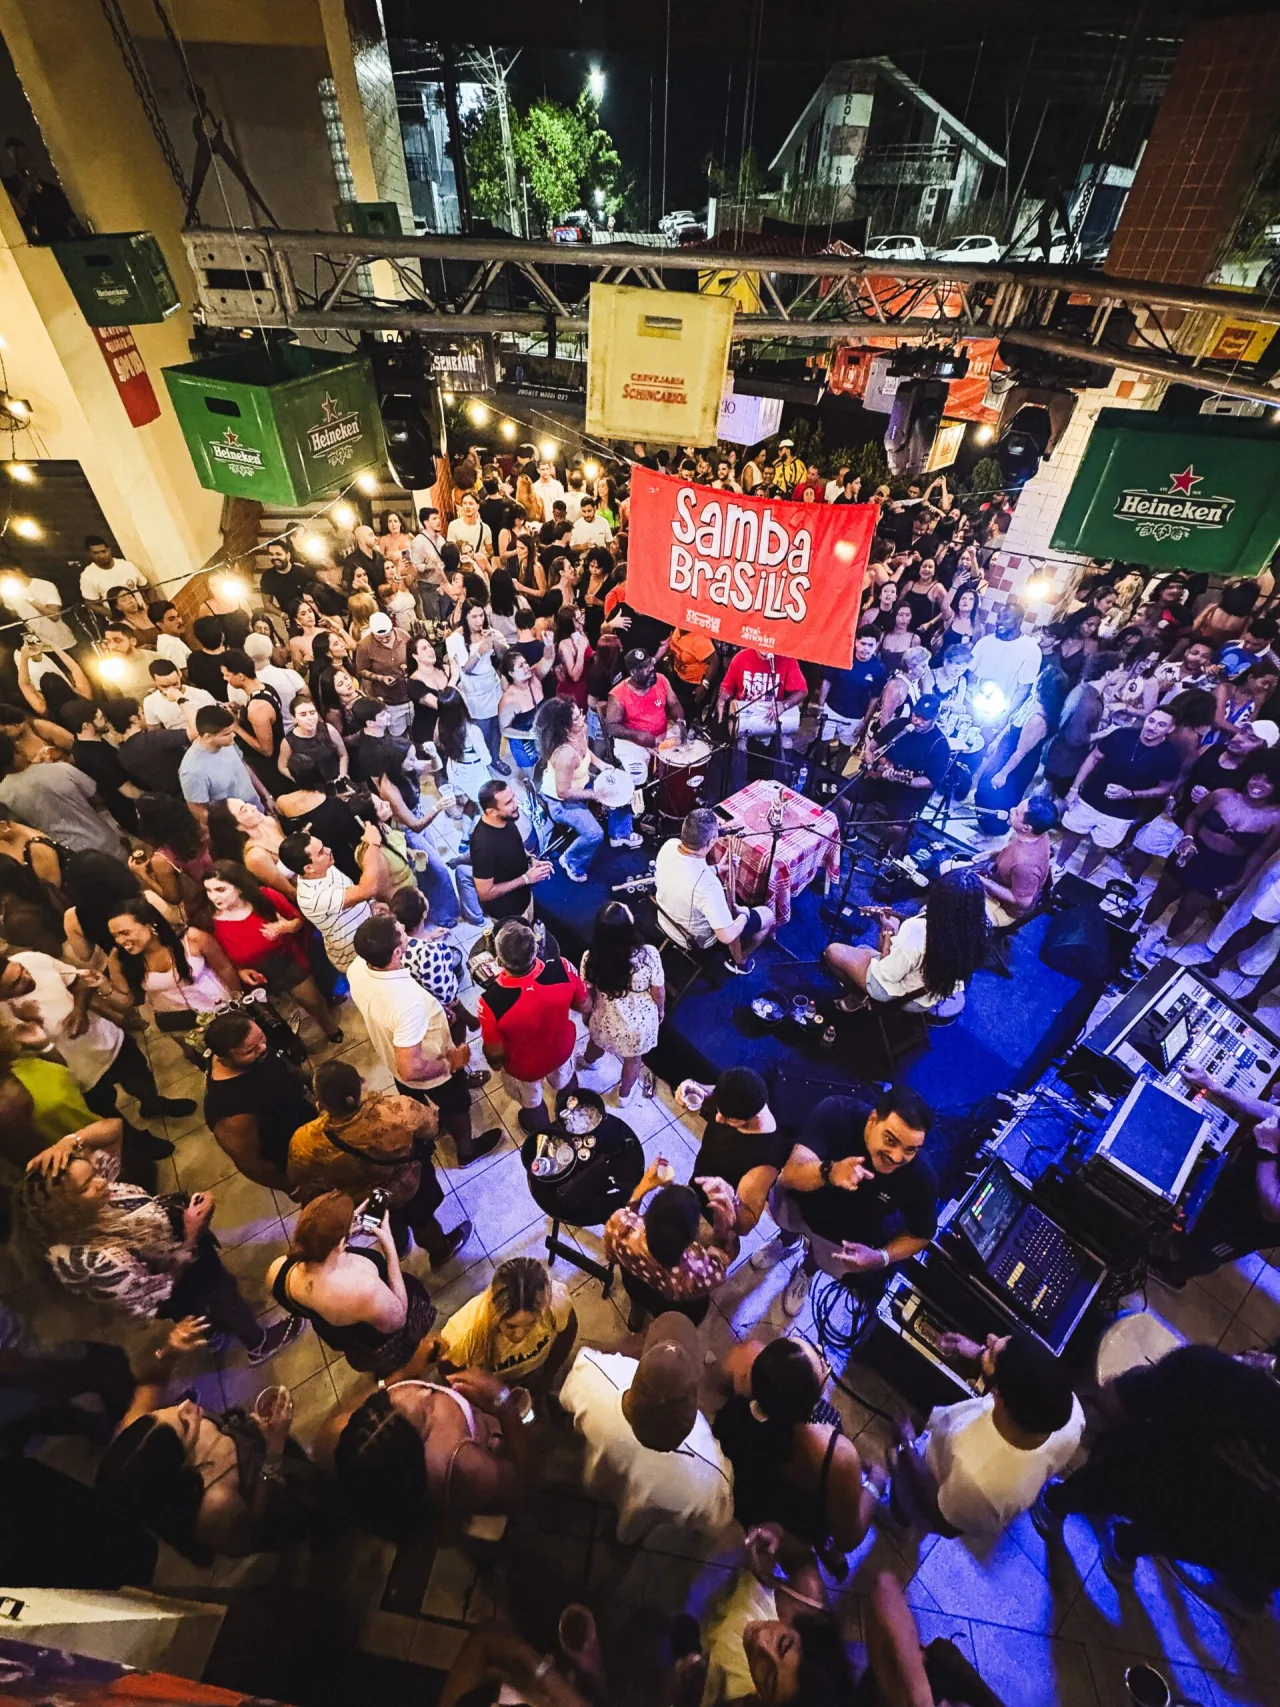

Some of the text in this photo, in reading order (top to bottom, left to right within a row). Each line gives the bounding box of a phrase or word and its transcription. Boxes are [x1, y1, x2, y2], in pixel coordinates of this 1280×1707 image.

[311, 419, 361, 452] Heineken
[213, 445, 263, 466] Heineken
[1120, 495, 1224, 523] Heineken
[670, 486, 812, 575] Samba
